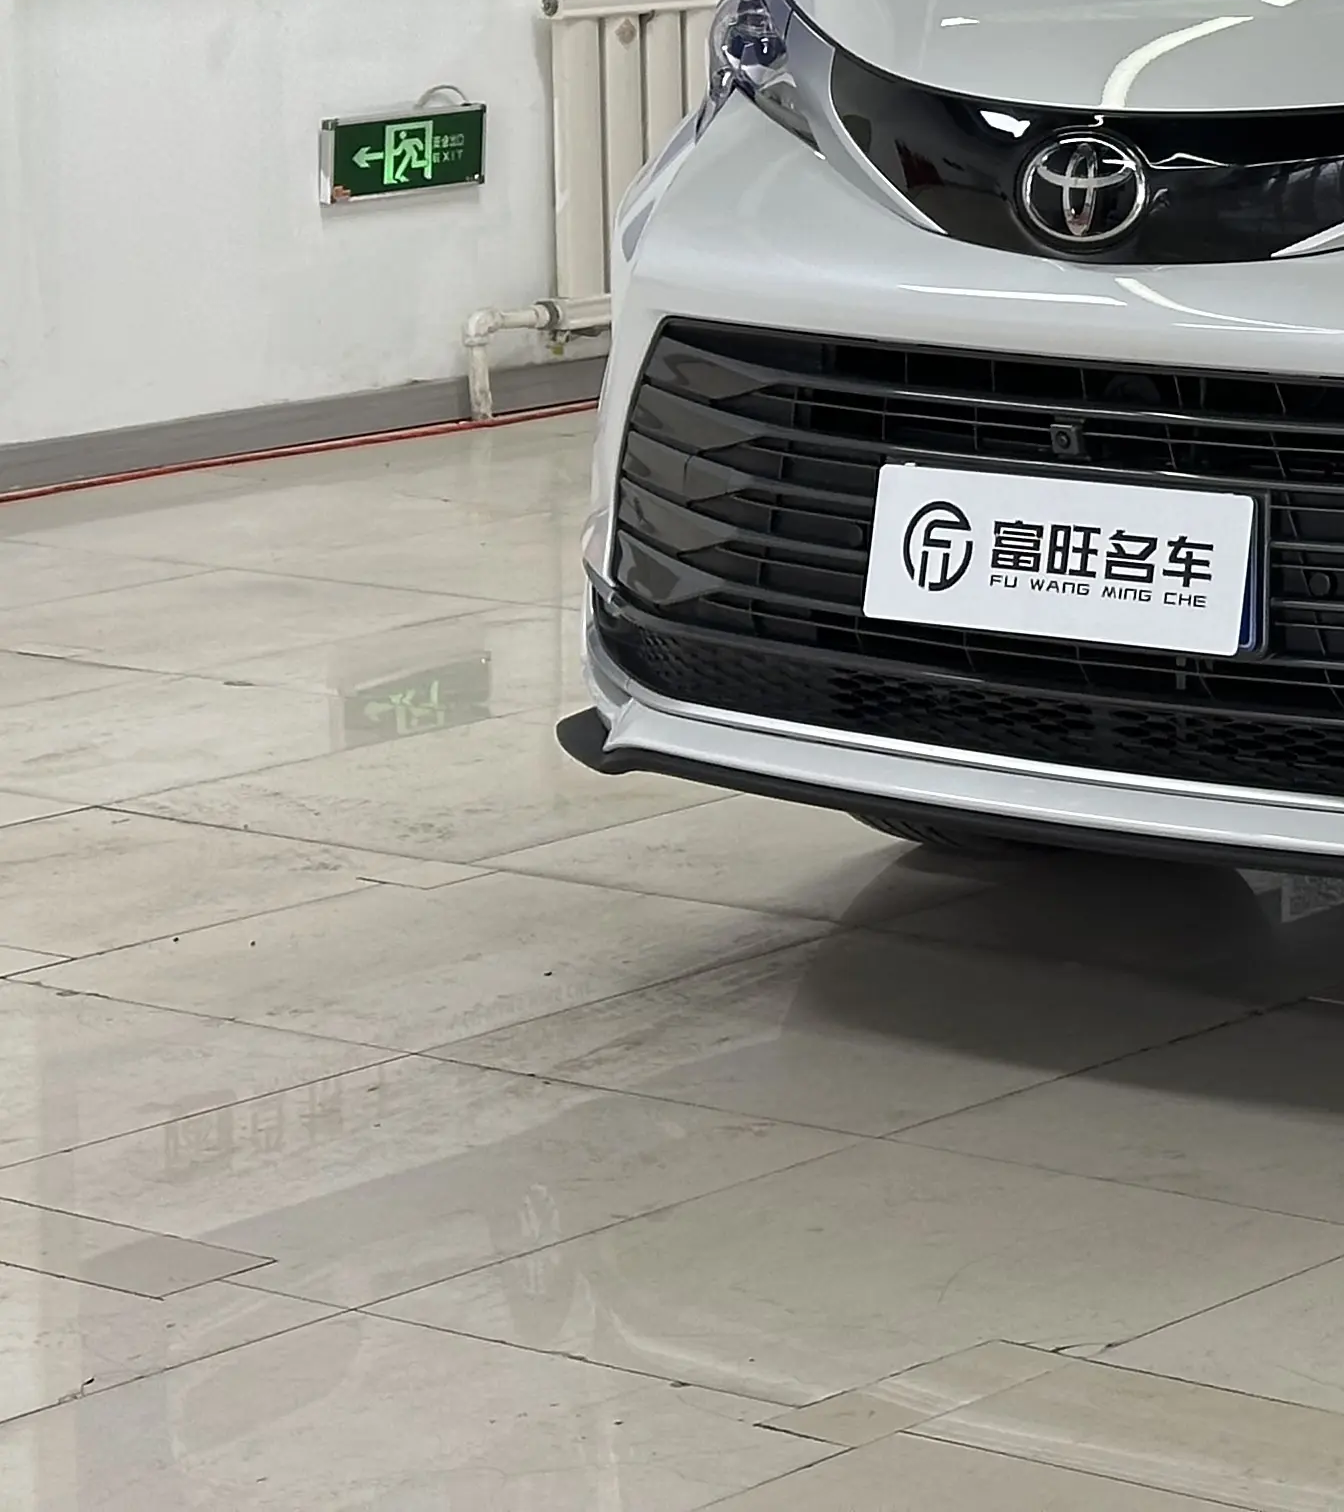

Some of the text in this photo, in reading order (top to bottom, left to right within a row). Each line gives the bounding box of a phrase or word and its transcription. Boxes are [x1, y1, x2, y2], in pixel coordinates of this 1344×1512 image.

[990, 520, 1215, 588] 富旺名车
[989, 574, 1207, 609] FU WANG MING CHE
